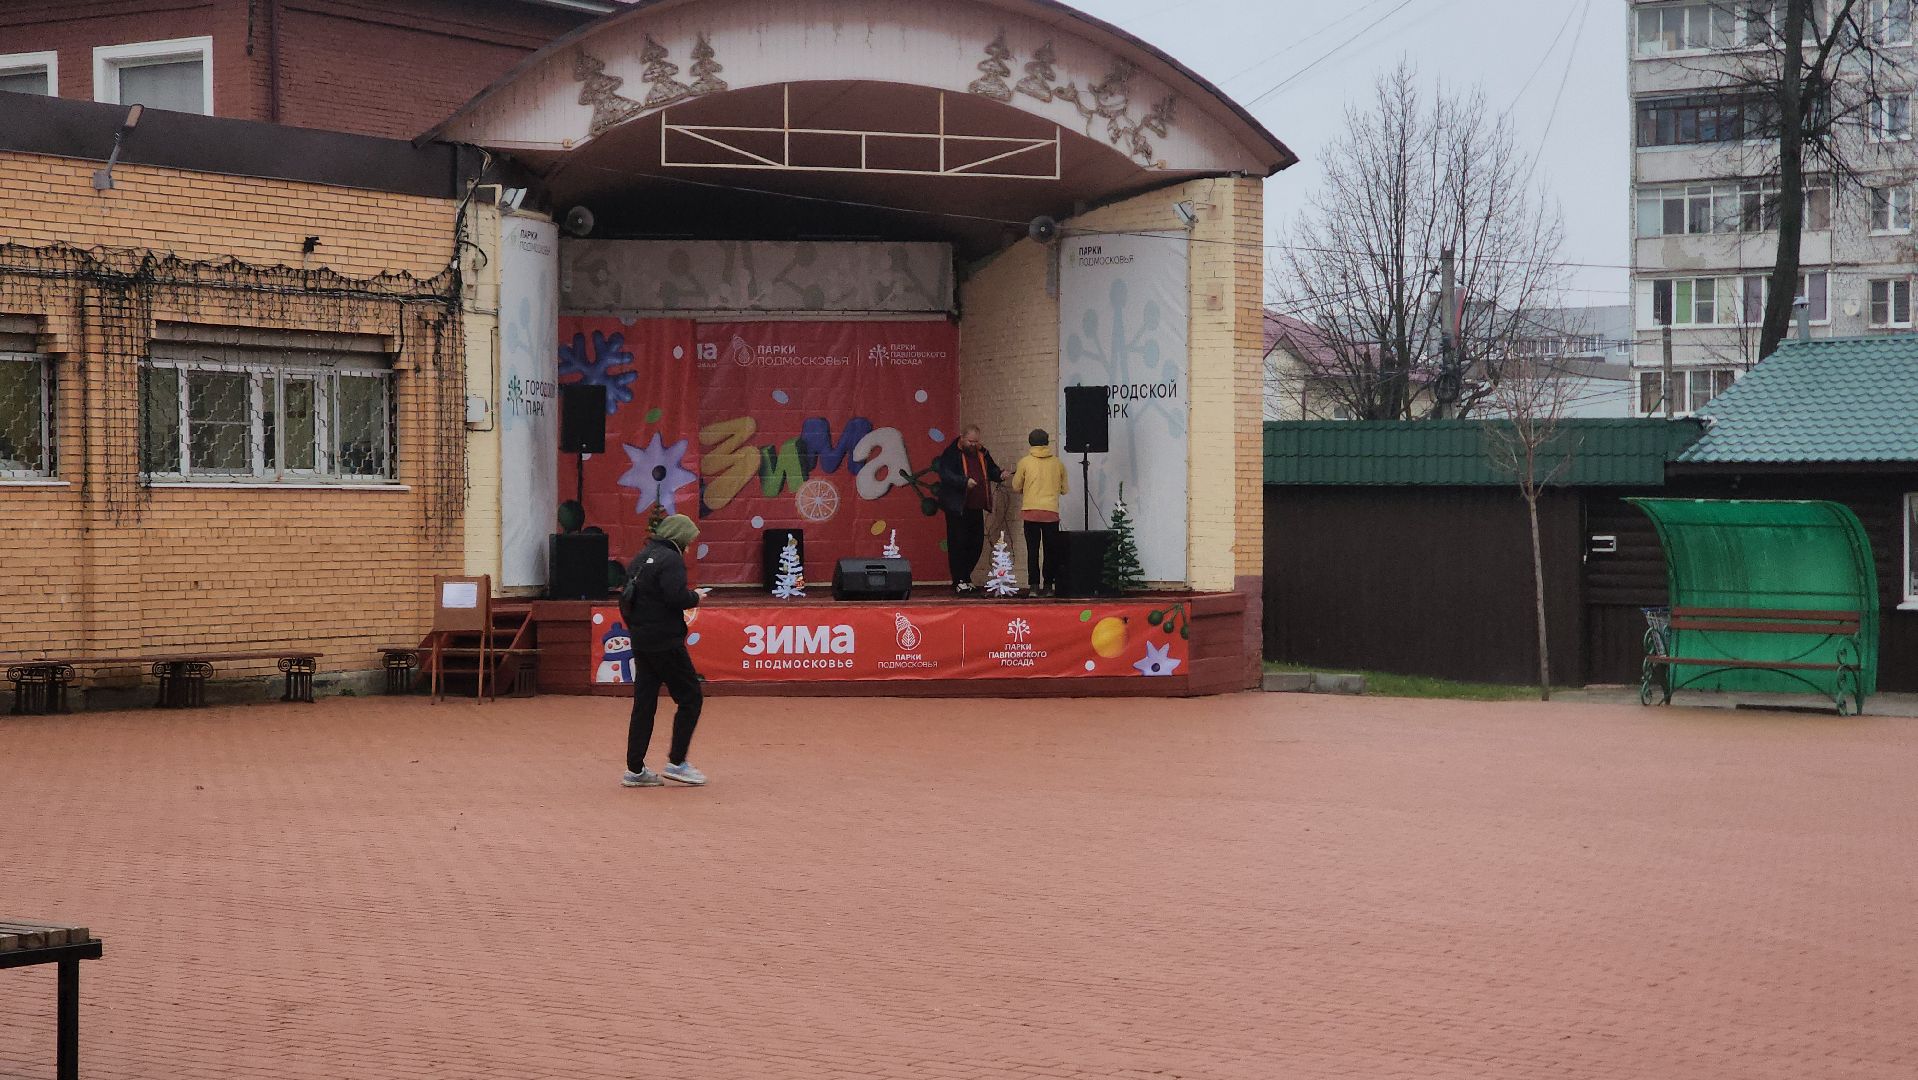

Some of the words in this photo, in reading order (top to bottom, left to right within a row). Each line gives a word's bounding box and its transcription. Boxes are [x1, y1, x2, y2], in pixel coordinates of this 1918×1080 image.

[1078, 246, 1102, 256] ПАРКИ
[757, 344, 797, 355] ПАРКИ
[890, 343, 916, 351] ПАРКИ
[757, 356, 850, 367] ПОДМОСКОВЬЯ
[890, 358, 923, 366] ПОСАДА
[1106, 378, 1177, 401] РОДСКОЙ
[525, 400, 545, 416] ПАРК
[1106, 403, 1129, 419] РК
[1004, 643, 1032, 651] ПАРКИ
[988, 650, 1048, 659] ПАВЛОВСКОГО
[877, 660, 938, 669] ПОДМОСКОВЬЯ
[1000, 658, 1034, 667] ПОСАДА
